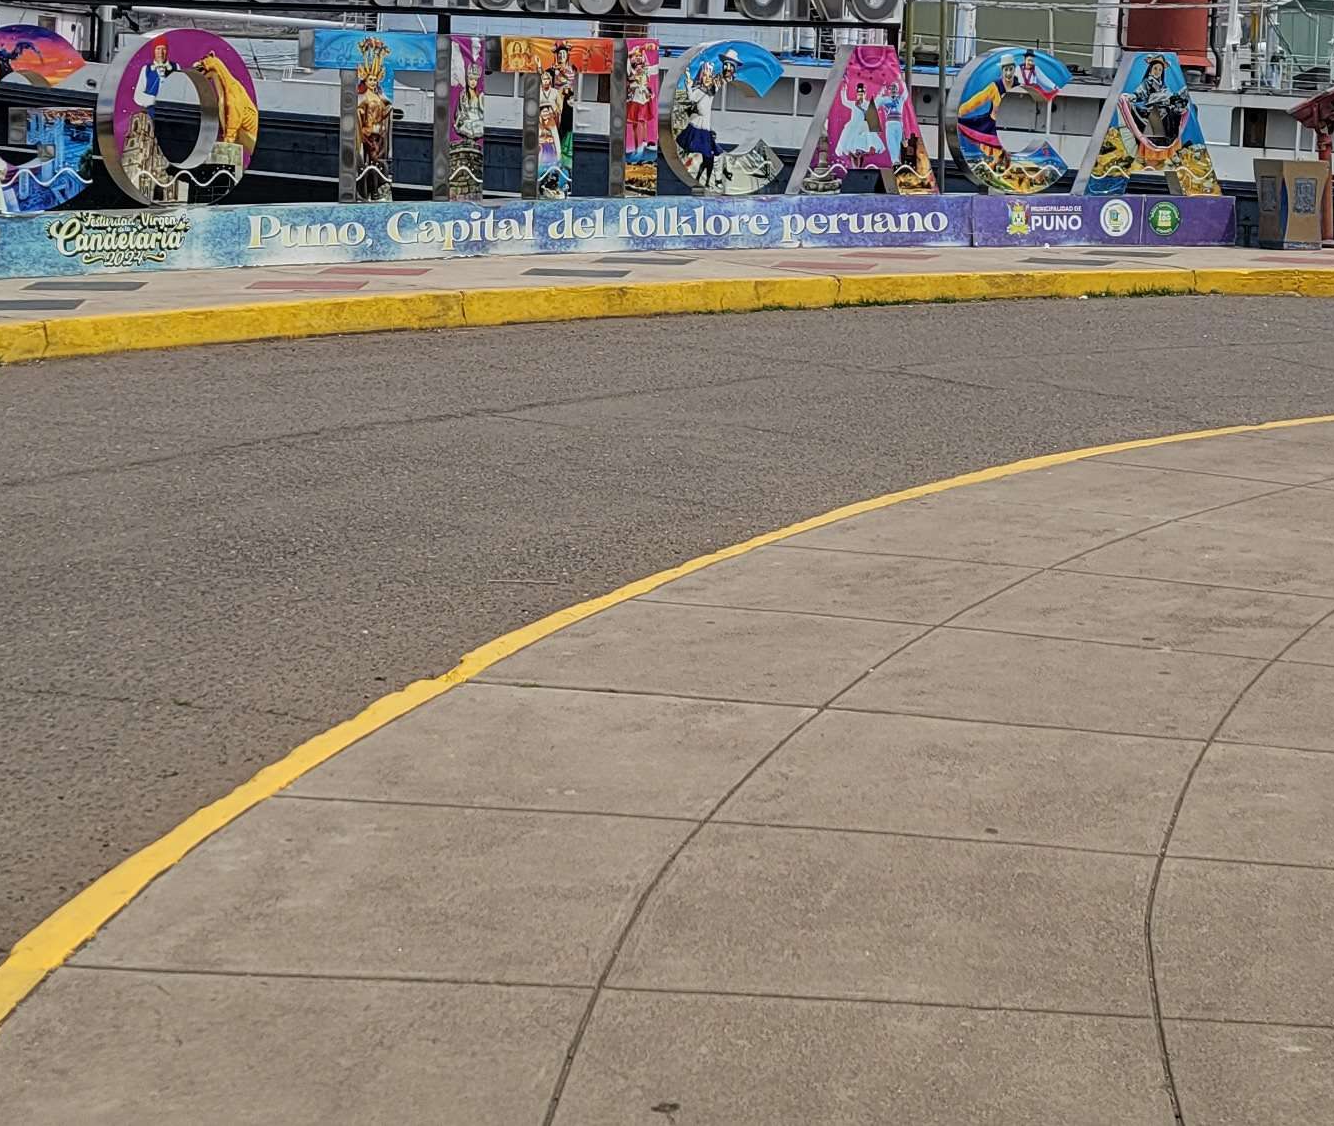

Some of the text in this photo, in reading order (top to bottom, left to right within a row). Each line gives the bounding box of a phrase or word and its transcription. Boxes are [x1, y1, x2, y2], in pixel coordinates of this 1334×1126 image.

[299, 29, 1223, 205] TITICACA
[138, 211, 177, 232] Virgen
[247, 204, 949, 252] Puno, Capital del folklore peruano
[1030, 214, 1082, 231] PUNO
[48, 218, 186, 256] Candelaria
[104, 250, 145, 267] 2024
